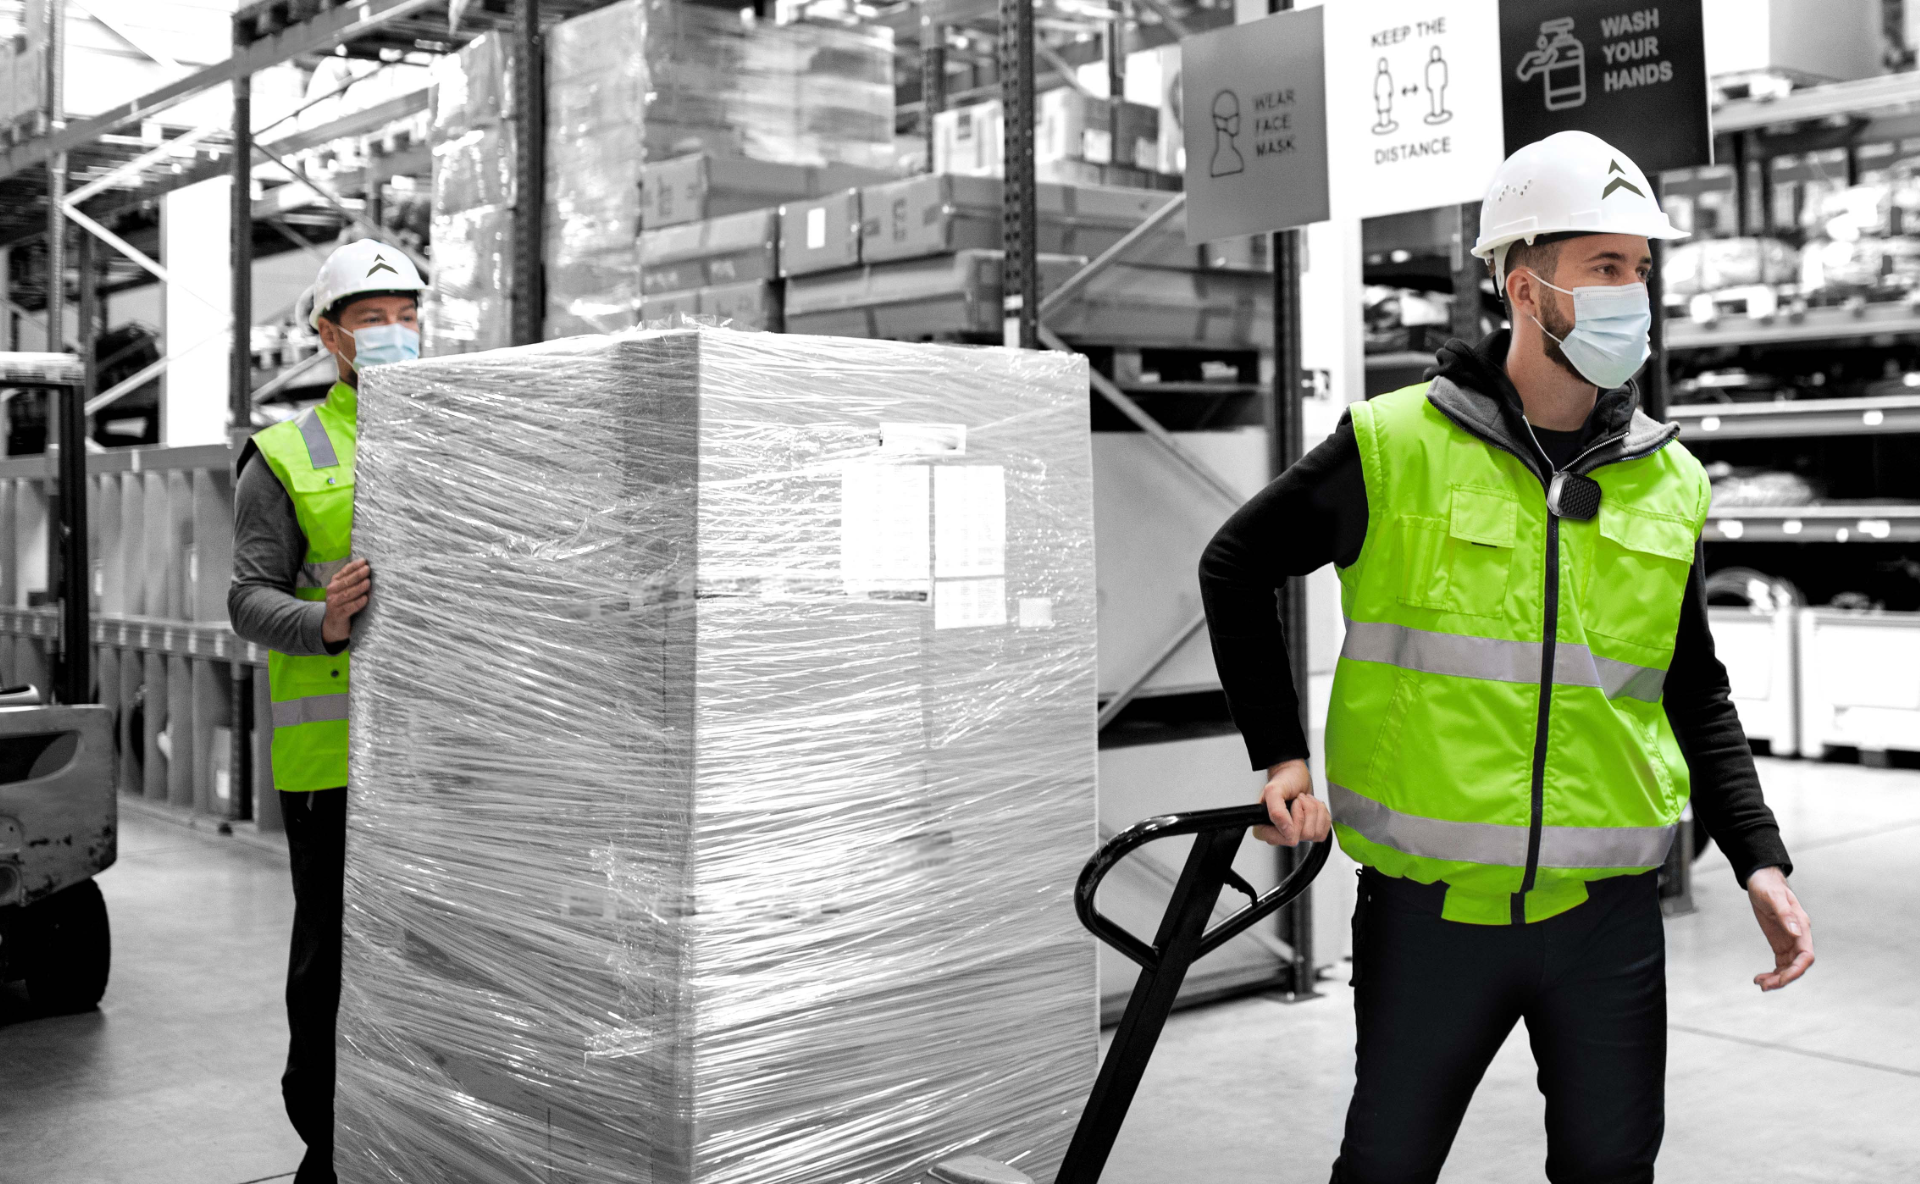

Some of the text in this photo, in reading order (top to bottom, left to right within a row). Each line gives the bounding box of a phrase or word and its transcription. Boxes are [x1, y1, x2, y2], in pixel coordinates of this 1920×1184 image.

[1371, 17, 1446, 47] KEEP THE
[1601, 8, 1659, 38] WASH
[1603, 36, 1659, 64] YOUR
[1604, 61, 1673, 92] HANDS
[1254, 89, 1295, 111] WEAR
[1255, 115, 1291, 133] FACE
[1256, 137, 1296, 157] MASK
[1374, 137, 1452, 165] DISTANCE
